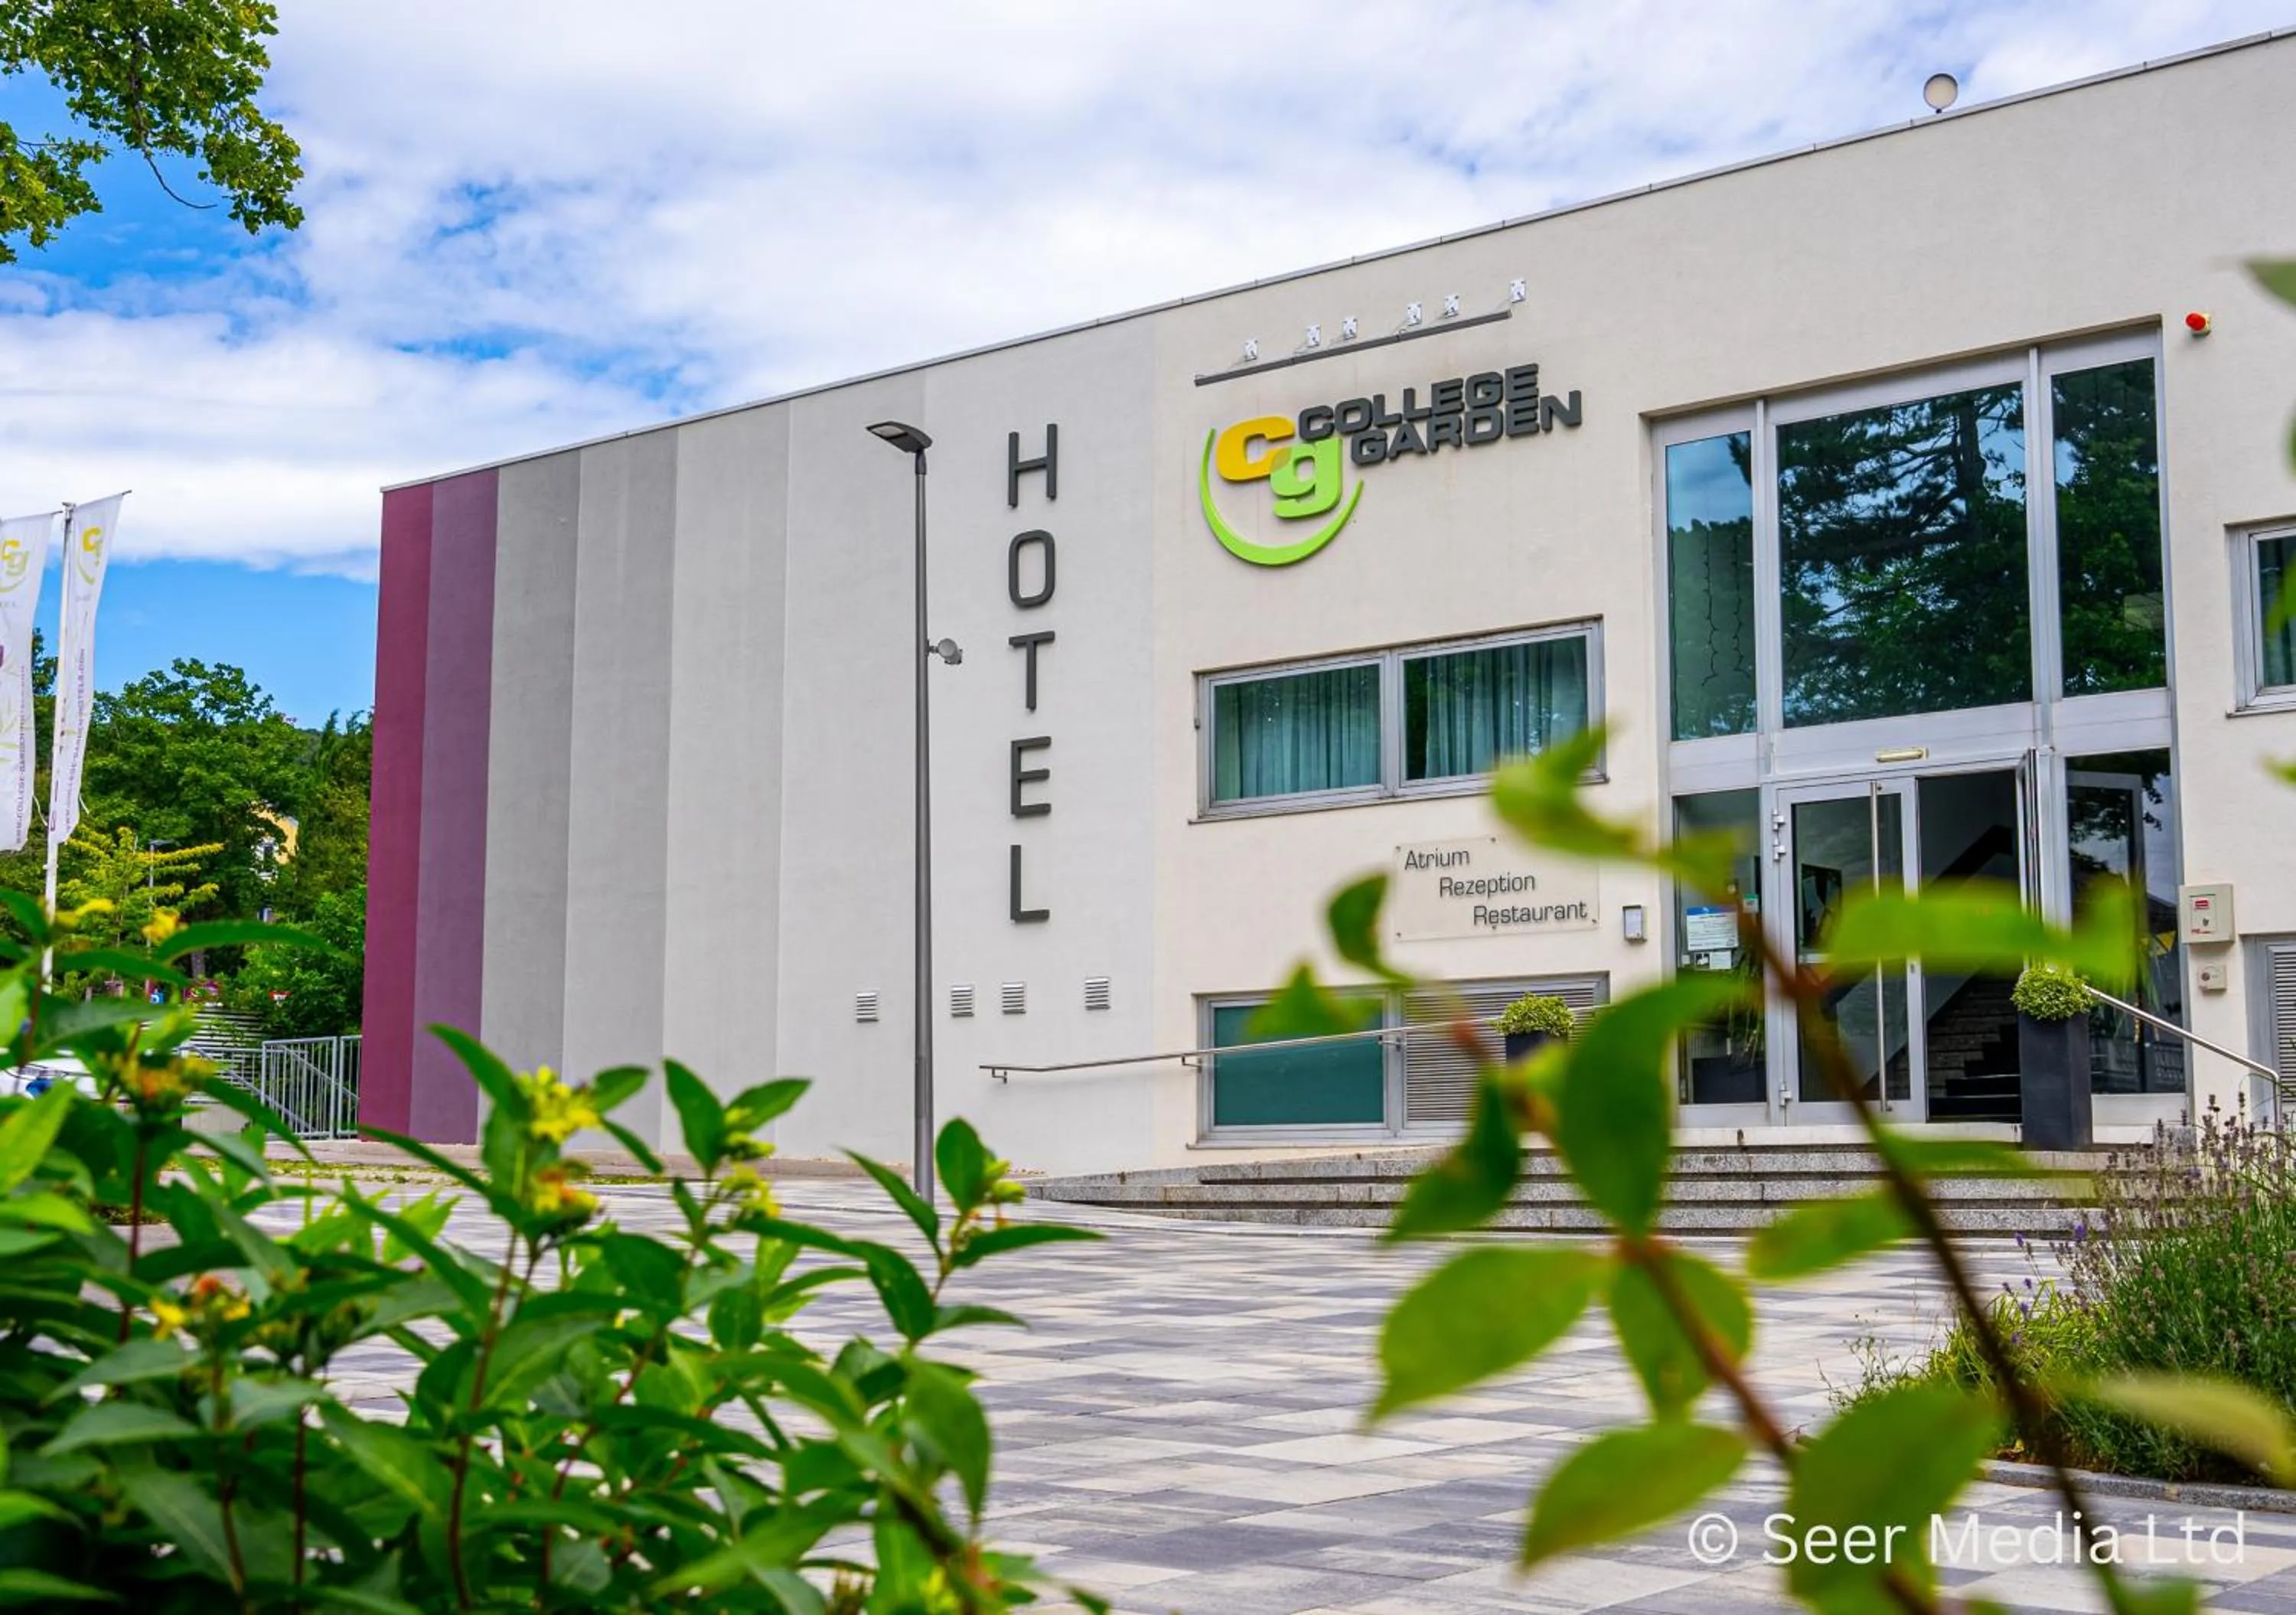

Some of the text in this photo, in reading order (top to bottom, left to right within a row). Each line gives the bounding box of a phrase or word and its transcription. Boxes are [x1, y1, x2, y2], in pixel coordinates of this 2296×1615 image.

[1298, 363, 1538, 442] COLLEGE
[1350, 390, 1582, 467] GARDEN
[1007, 423, 1058, 923] HOTEL
[1404, 847, 1471, 871] Atrium
[1439, 872, 1536, 900] Rezeption
[1473, 900, 1589, 927] Restaurant
